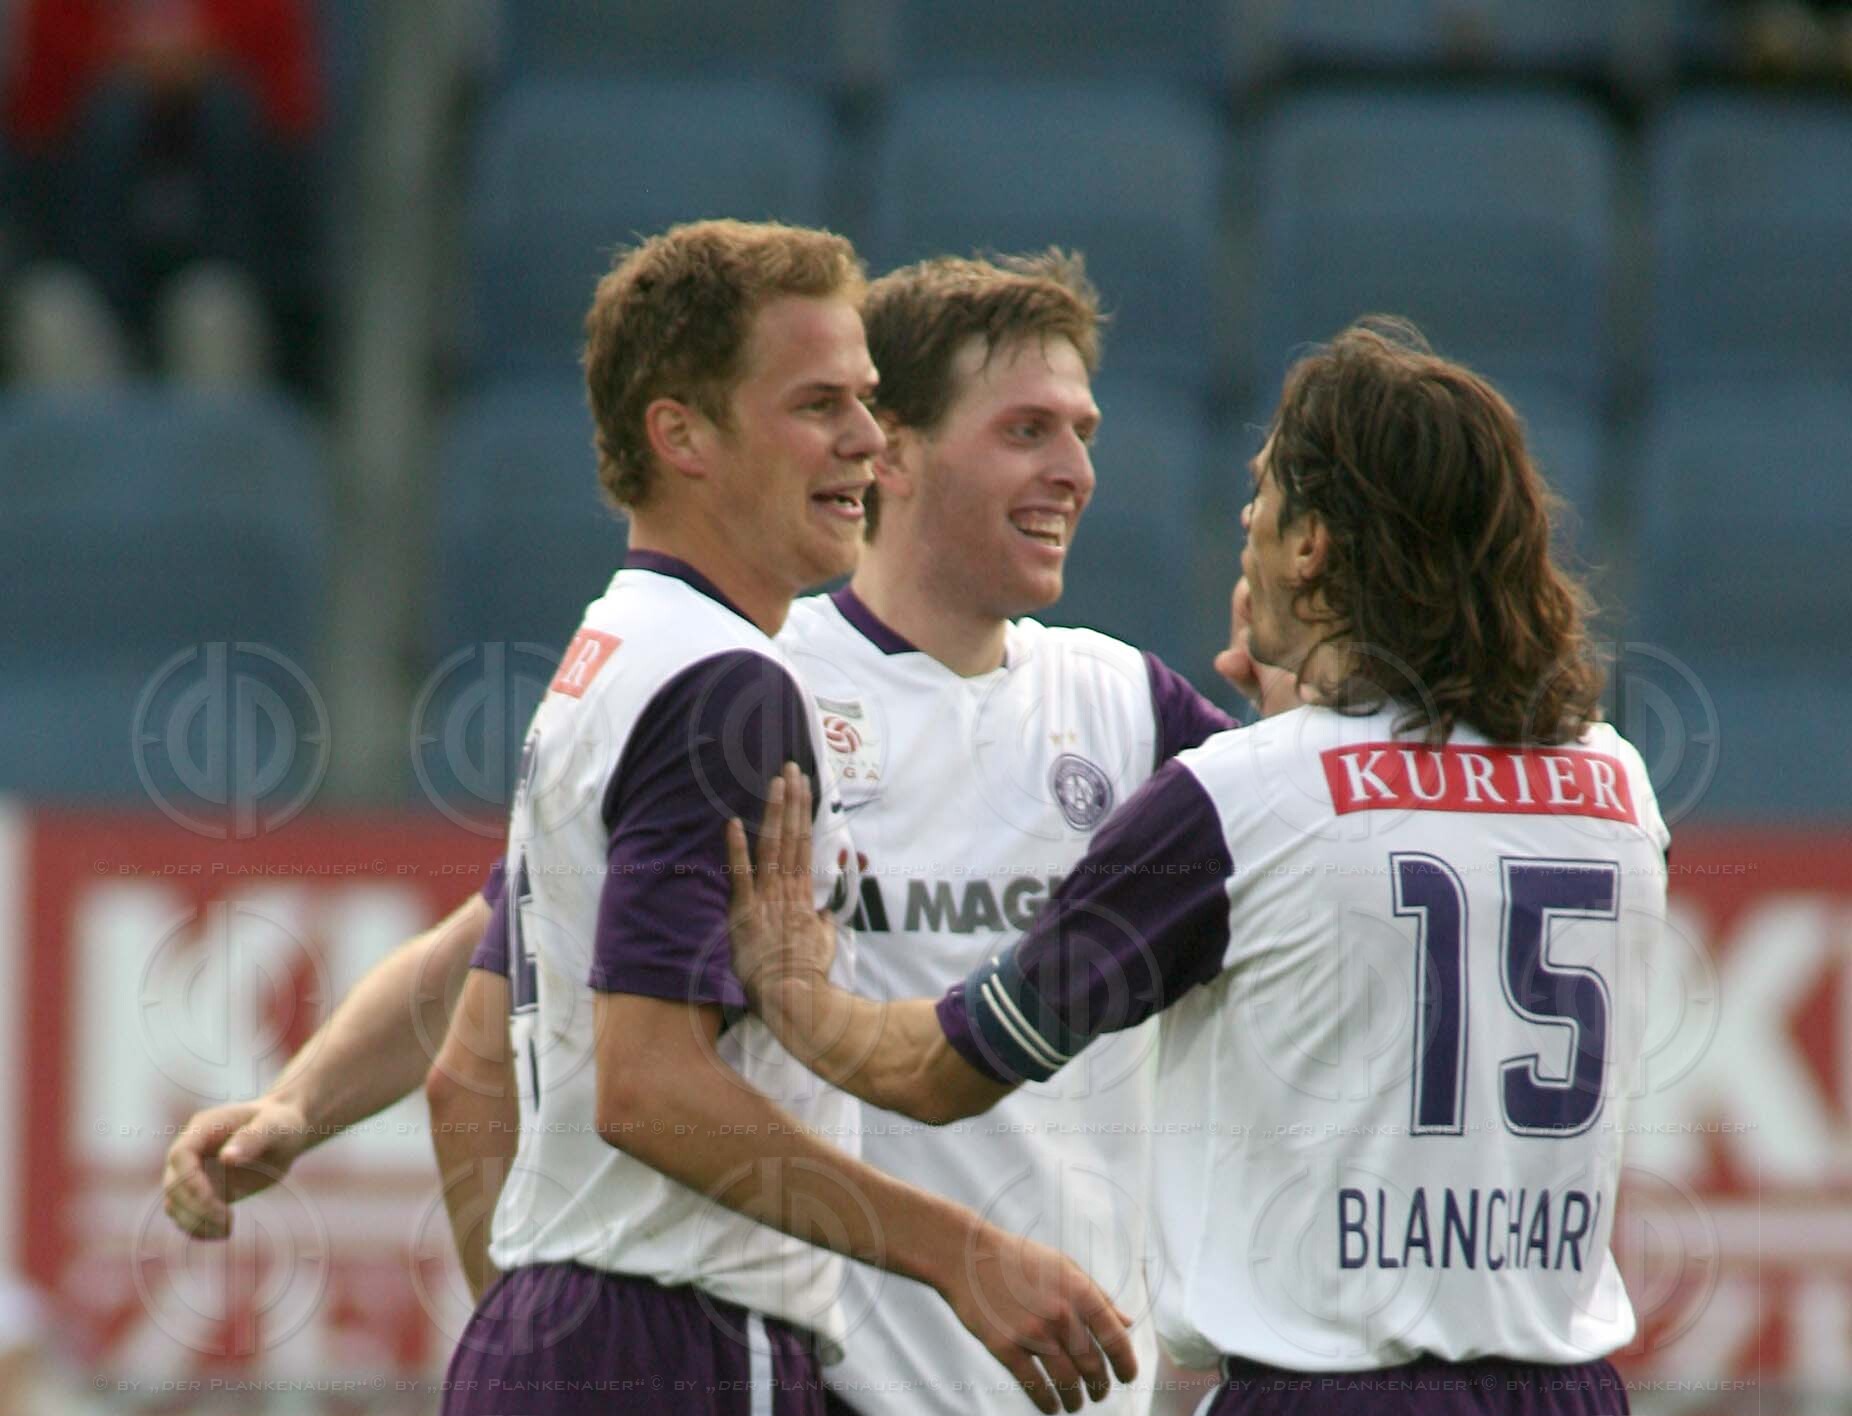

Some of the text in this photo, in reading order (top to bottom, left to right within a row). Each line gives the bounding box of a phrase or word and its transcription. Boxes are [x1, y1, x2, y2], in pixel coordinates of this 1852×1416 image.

[1338, 750, 1626, 813] KURIER
[904, 875, 1071, 933] MAG
[1390, 851, 1620, 1138] 15
[1338, 1186, 1602, 1272] BLANCHAR
